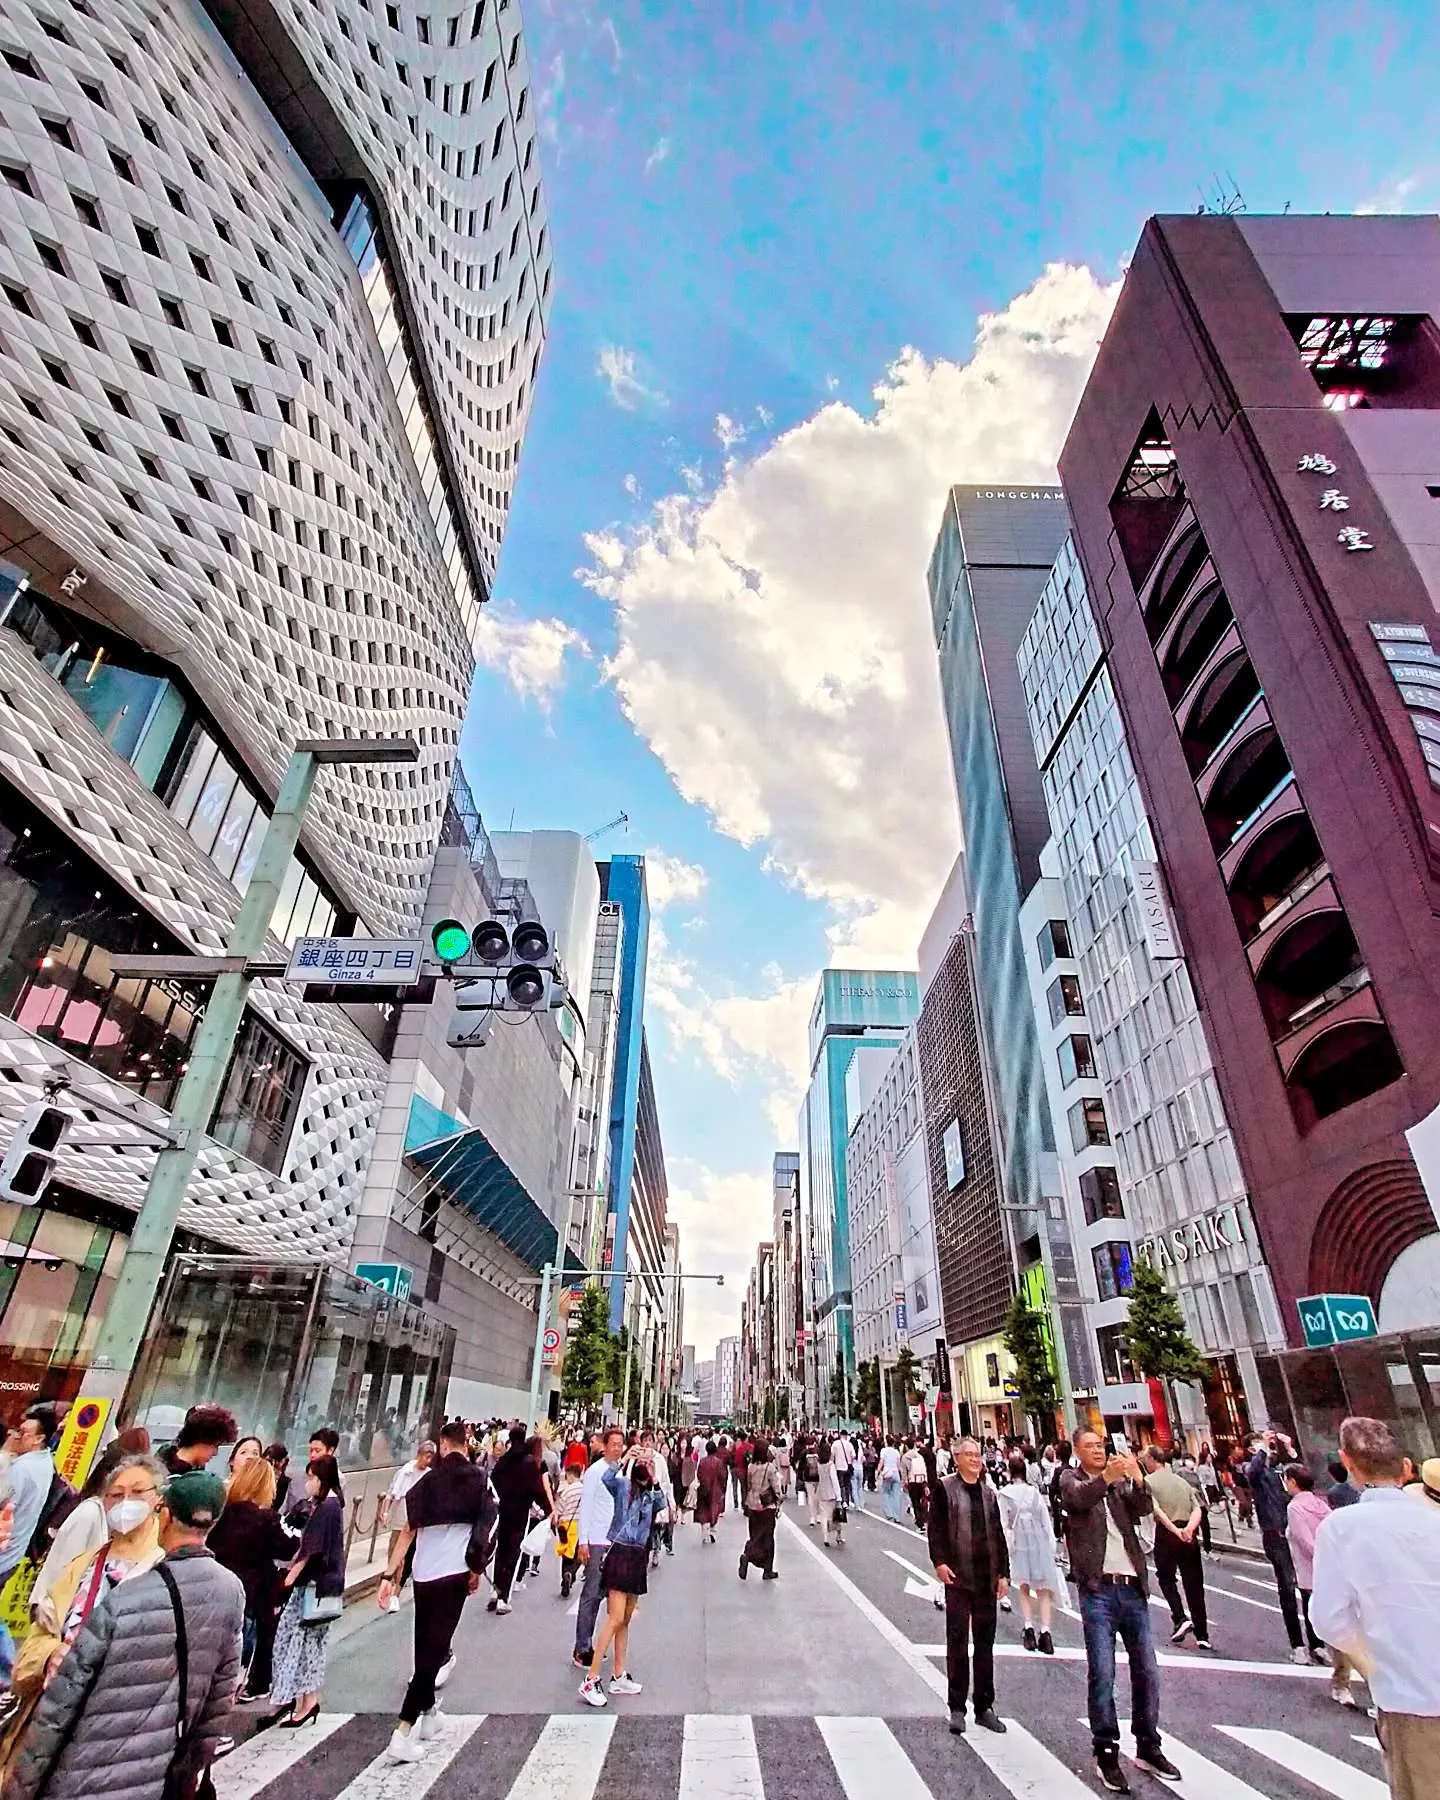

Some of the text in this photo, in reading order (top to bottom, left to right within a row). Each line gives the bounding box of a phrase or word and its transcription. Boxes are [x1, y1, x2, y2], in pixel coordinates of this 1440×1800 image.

[976, 491, 1064, 500] LONGCHAM
[1297, 453, 1375, 551] 鳩居堂
[1138, 872, 1169, 946] TASAKI
[303, 939, 340, 948] 中央区
[298, 949, 415, 968] 銀座四丁目
[328, 968, 375, 980] Ginza 4
[1139, 1207, 1246, 1269] TASAKI
